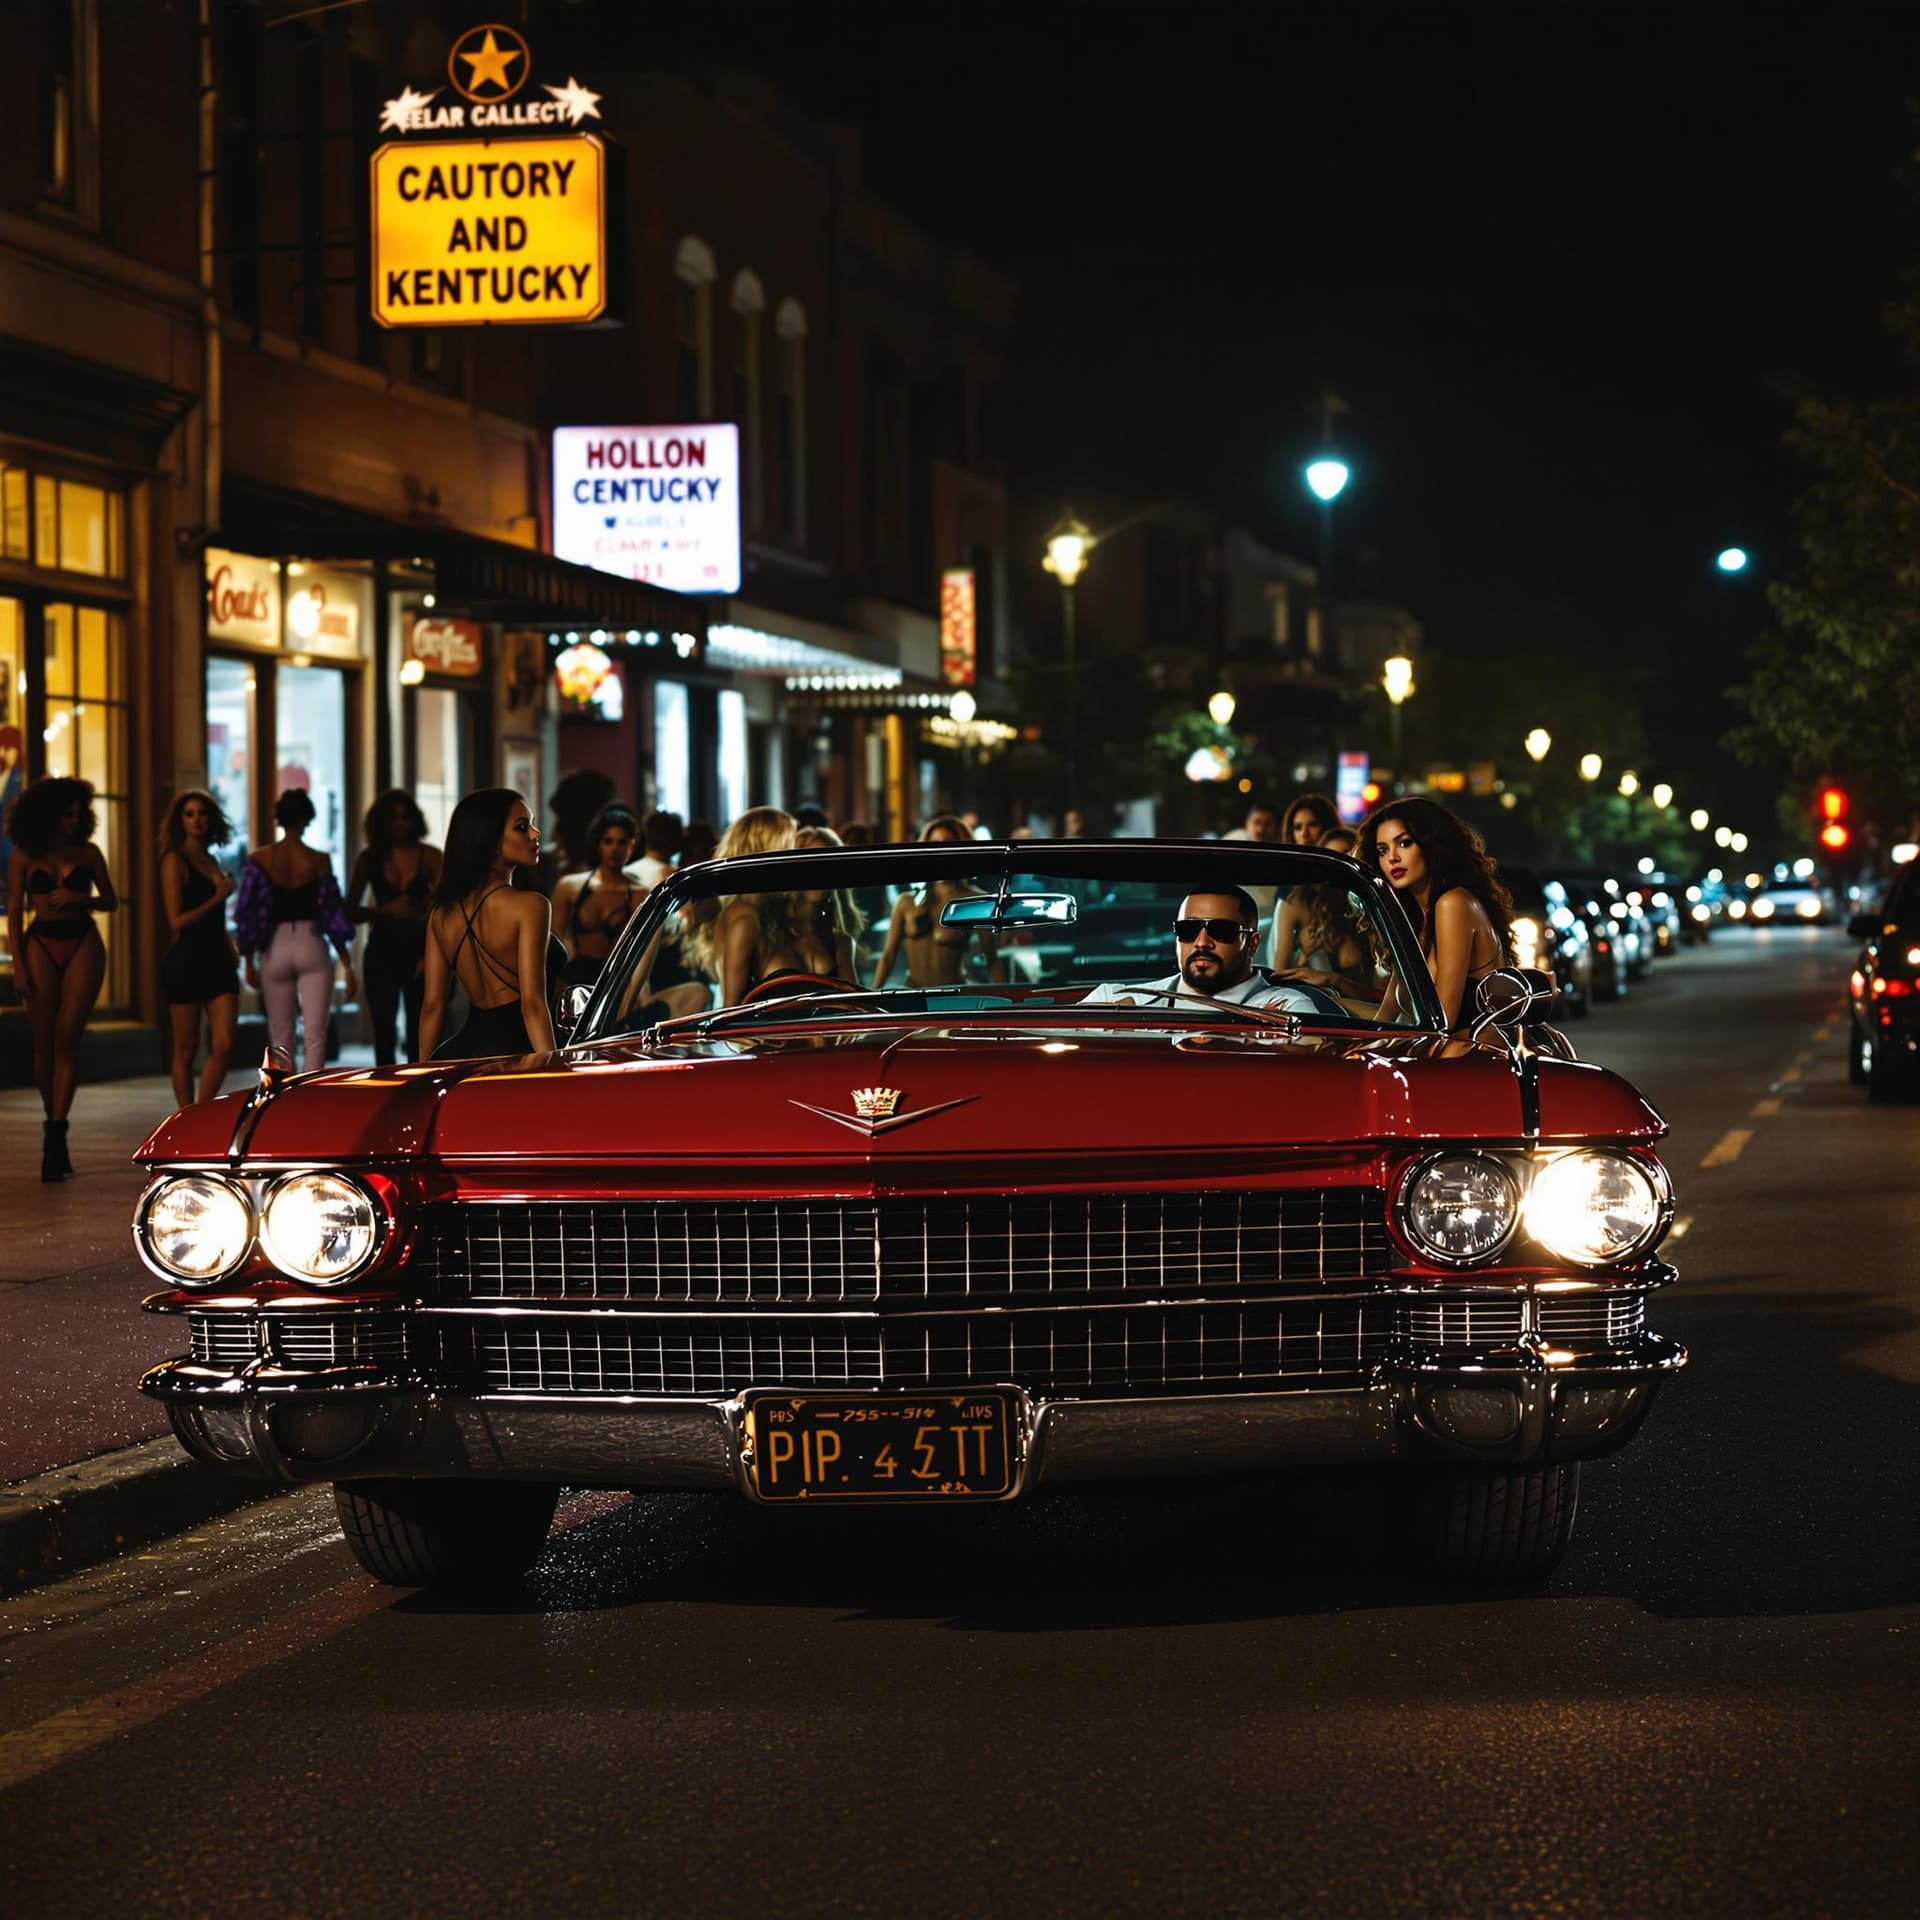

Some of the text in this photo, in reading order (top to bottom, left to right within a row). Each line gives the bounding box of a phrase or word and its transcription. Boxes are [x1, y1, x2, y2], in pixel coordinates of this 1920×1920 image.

[398, 160, 575, 202] CAUTORY
[447, 215, 528, 253] AND
[387, 263, 591, 307] KENTUCKY
[587, 437, 706, 470] HOLLON
[573, 477, 721, 505] CENTUCKY
